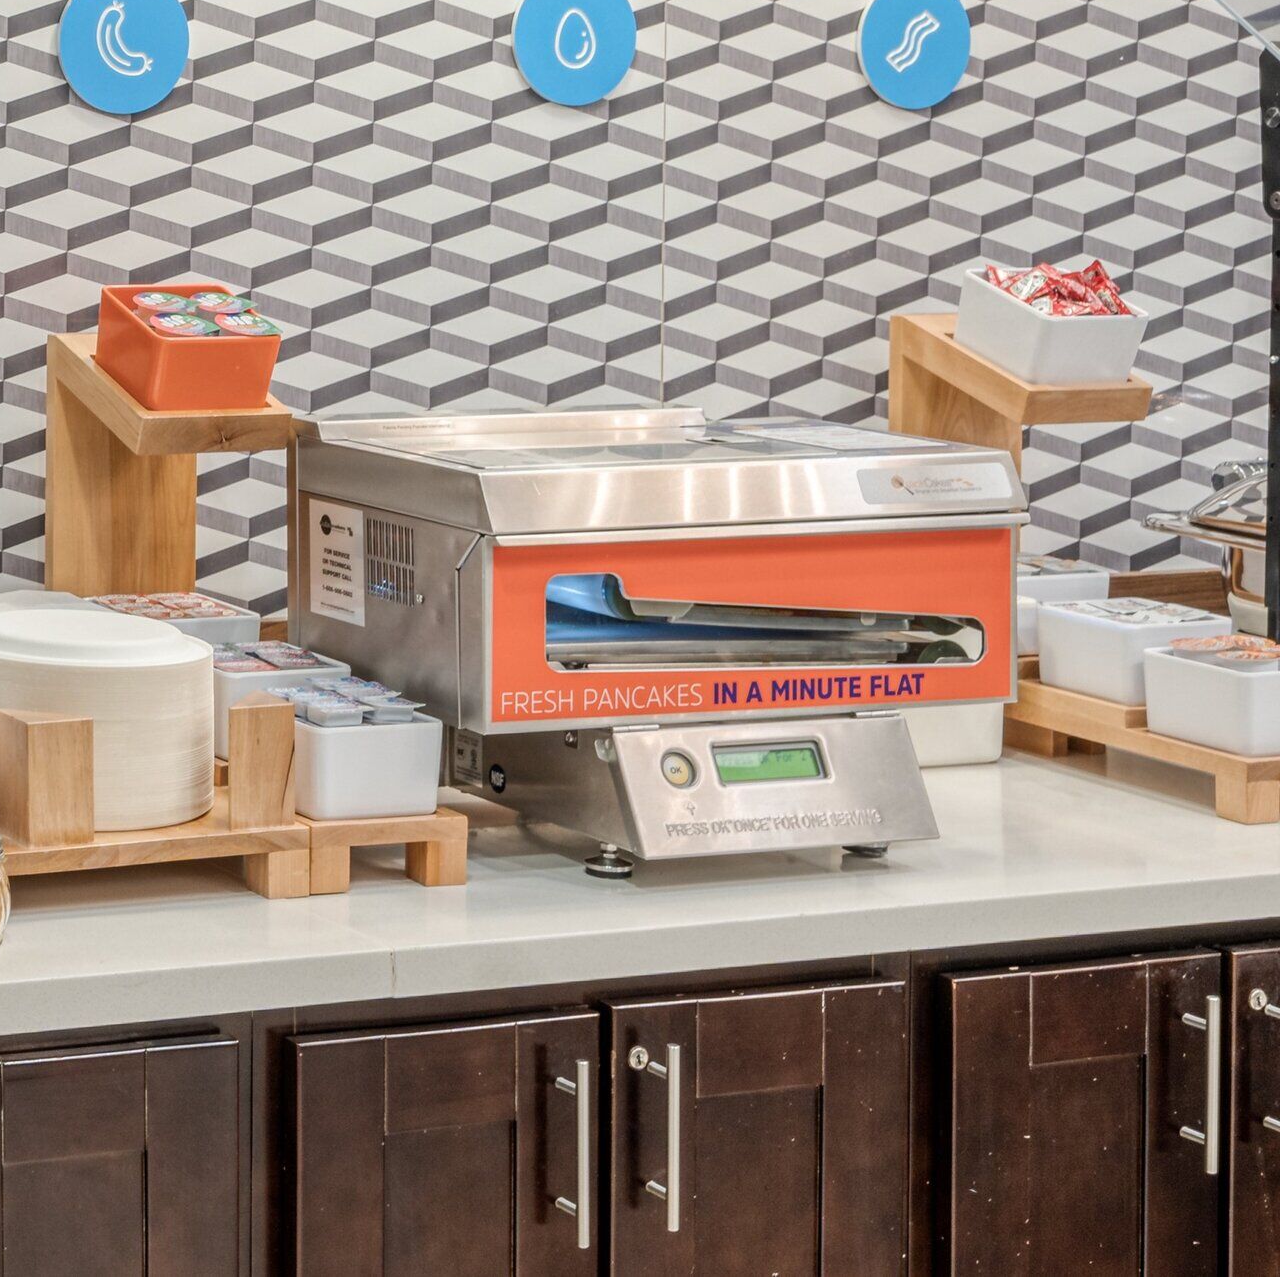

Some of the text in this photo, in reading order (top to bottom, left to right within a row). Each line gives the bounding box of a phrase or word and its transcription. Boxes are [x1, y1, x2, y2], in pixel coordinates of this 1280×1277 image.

[501, 673, 926, 715] FRESH PANCAKES IN A MINUTE FLAT
[491, 770, 505, 787] NSF
[670, 766, 682, 774] OK
[665, 822, 710, 837] PRESS
[774, 816, 801, 830] FOR
[803, 813, 830, 828] ONE
[830, 809, 883, 827] SERVING
